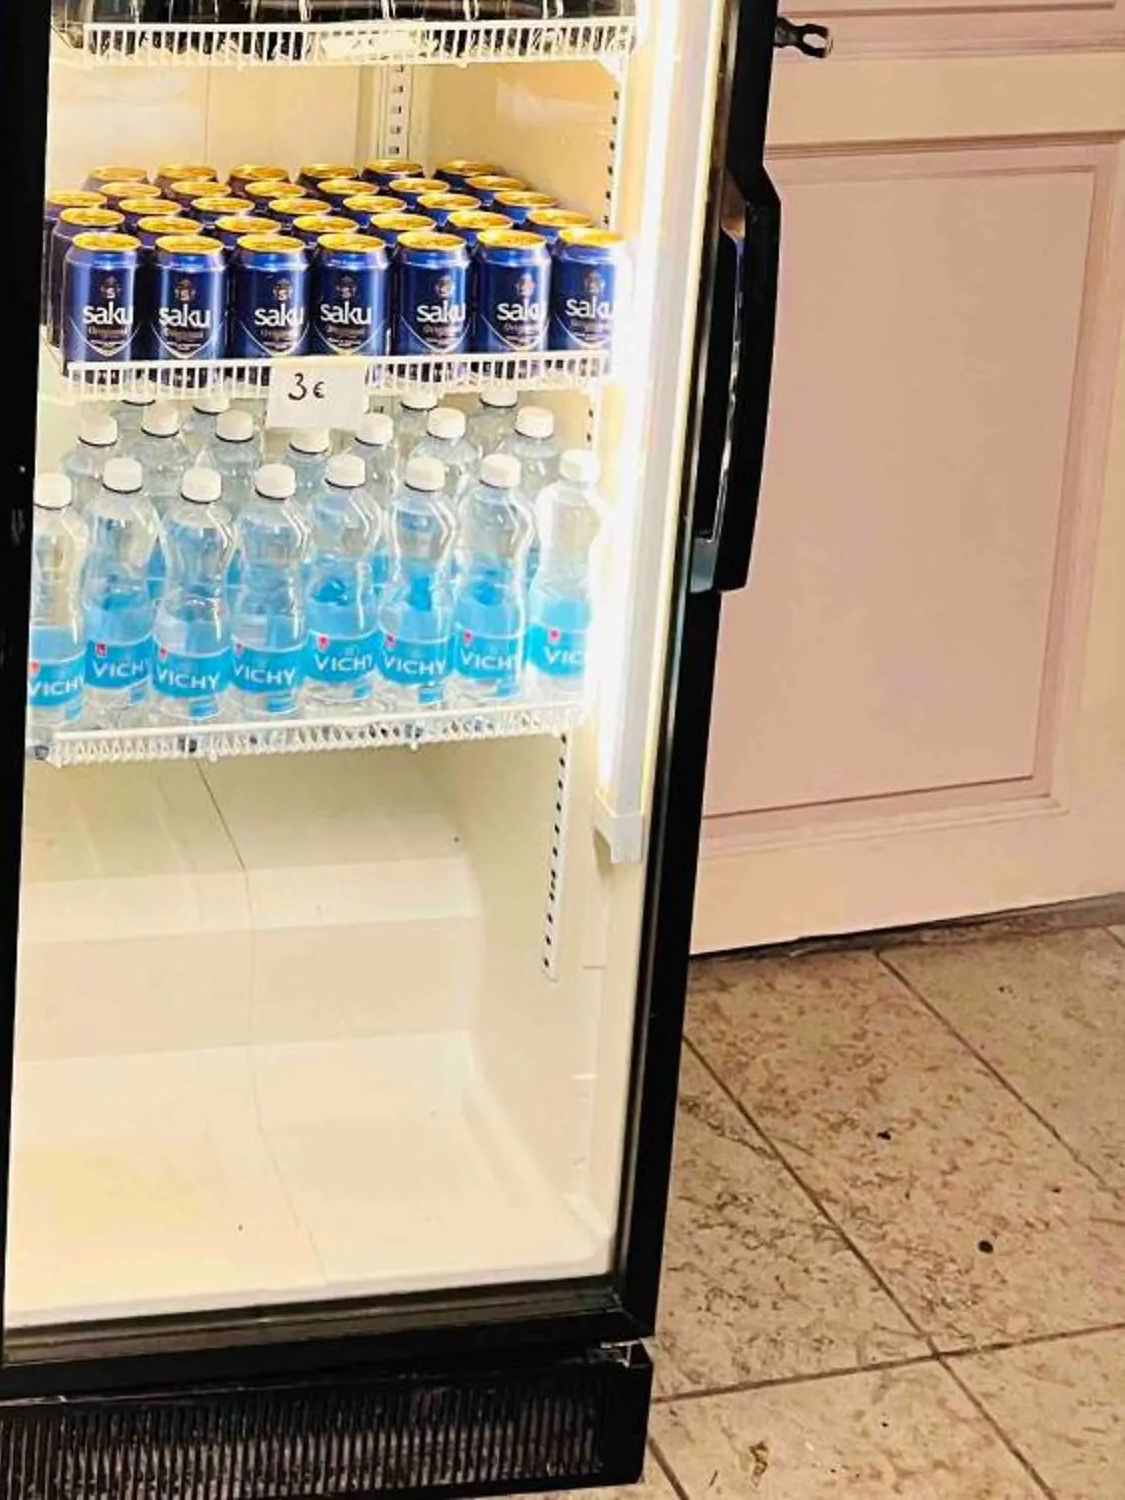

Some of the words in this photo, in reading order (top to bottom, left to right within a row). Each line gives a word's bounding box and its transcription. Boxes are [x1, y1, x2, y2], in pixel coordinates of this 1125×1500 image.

[82, 301, 134, 325] saku
[158, 303, 212, 328] saku
[254, 303, 304, 327] saku
[320, 301, 372, 325] saku
[233, 661, 296, 686] VICHY
[381, 650, 446, 676] VICHY
[156, 663, 220, 690] VICHY
